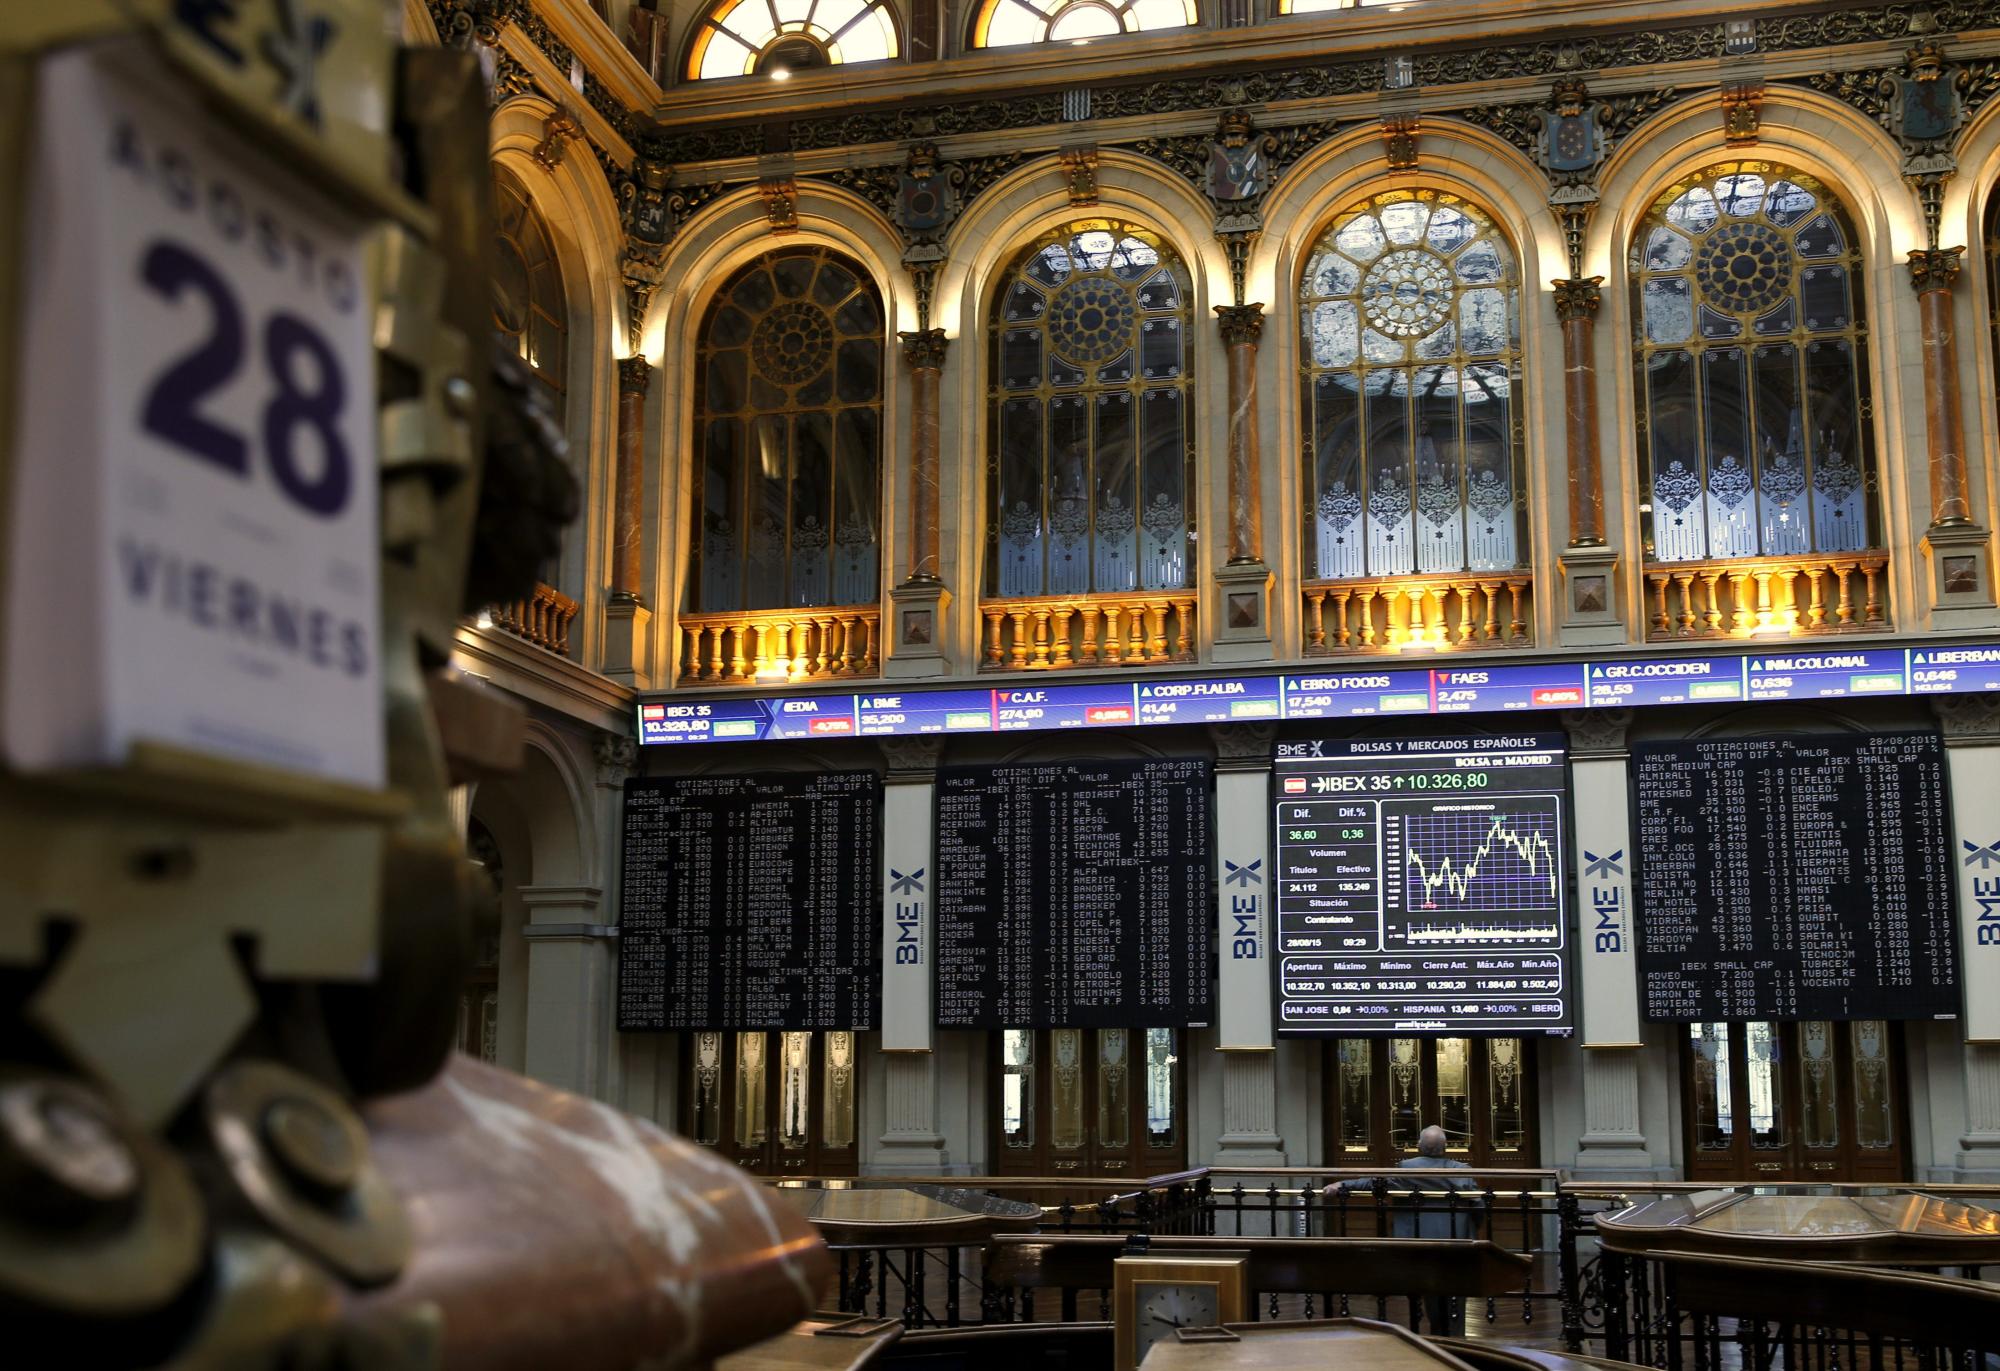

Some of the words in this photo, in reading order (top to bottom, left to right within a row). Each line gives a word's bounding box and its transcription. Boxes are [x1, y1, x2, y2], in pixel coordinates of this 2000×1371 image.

[109, 116, 360, 316] AGOSTO
[136, 236, 353, 517] 28
[117, 533, 368, 679] VIERNES
[1765, 656, 1868, 670] INM.COLONIAL
[1605, 663, 1709, 677] GR.C.OCCIDEN
[1452, 672, 1488, 684] FAES
[1913, 670, 1957, 683] 0,646
[1300, 678, 1338, 689] EBRO
[1342, 676, 1390, 688] FOODS
[1751, 678, 1792, 689] 0,636
[1154, 683, 1244, 697] CORP.FI.ALBA
[1012, 692, 1048, 703] C.A.F.
[1288, 696, 1331, 707] 17,540
[1438, 691, 1477, 702] 2,475
[874, 698, 902, 708] BME
[667, 706, 694, 717] IBEX
[696, 705, 711, 716] 35
[1142, 703, 1176, 714] 41,44
[1351, 743, 1392, 752] BOLSAS
[1396, 742, 1403, 750] Y
[1408, 740, 1468, 750] MERCADOS
[1474, 737, 1536, 748] ESPAÑOLES
[1697, 742, 1776, 751] COTIZACIONES
[1783, 740, 1795, 748] AL
[1870, 736, 1937, 745] 28/08/2015
[1278, 744, 1307, 755] BME
[1455, 758, 1490, 767] BOLSA
[1505, 755, 1552, 765] MADRID
[1704, 752, 1743, 760] ULTIMO
[1144, 762, 1204, 770] 28/08/2015
[1640, 764, 1664, 772] IBEX
[1672, 762, 1710, 770] MEDIUM
[1133, 771, 1168, 779] ULTIMO
[1705, 770, 1744, 778] 16.910
[1326, 776, 1366, 792] IBEX
[1371, 776, 1391, 790] 35
[1408, 773, 1487, 790] 10.326,80
[1074, 790, 1120, 798] MEDIASET
[1640, 790, 1692, 798] ATRESMED
[1706, 788, 1744, 796] 13.260
[1792, 794, 1838, 802] EDREAMS
[1866, 792, 1899, 800] 2.450
[1706, 797, 1745, 805] 35.150
[1294, 809, 1311, 818] Dif.
[1339, 808, 1366, 817] Dif.%
[1700, 806, 1745, 815] 274.900
[1867, 811, 1900, 819] 0.607
[1289, 831, 1316, 840] 36,60
[1342, 830, 1364, 839] 0,36
[1714, 833, 1746, 841] 2.475
[1074, 842, 1120, 850] TECNICAS
[1795, 840, 1841, 848] FLUIDRA
[1869, 838, 1902, 846] 3.050
[1643, 862, 1695, 870] LIBERBAN
[1310, 899, 1348, 907] Situación
[1798, 904, 1832, 912] PRISA
[1873, 903, 1906, 911] 6.010
[1974, 877, 2000, 945] BME
[1593, 886, 1620, 952] BME
[1232, 895, 1256, 959] BME
[1646, 926, 1698, 934] VISCOFAN
[896, 903, 918, 964] BME
[1287, 939, 1321, 947] 28/08/15
[1287, 963, 1323, 972] Apertura
[1334, 962, 1366, 970] Máximo
[1754, 961, 1774, 969] CAP
[1878, 977, 1911, 985] 1.710
[1286, 983, 1325, 991] 10.322,70
[1331, 982, 1370, 991] 10.352,10
[1377, 982, 1416, 990] 10.313,00
[1364, 1006, 1388, 1014] 0,00%
[1403, 1005, 1446, 1013] HISPANIA
[1492, 1005, 1517, 1013] 0,00%
[1650, 1008, 1702, 1017] CEM.PORT
[1723, 1008, 1756, 1016] 6.860
